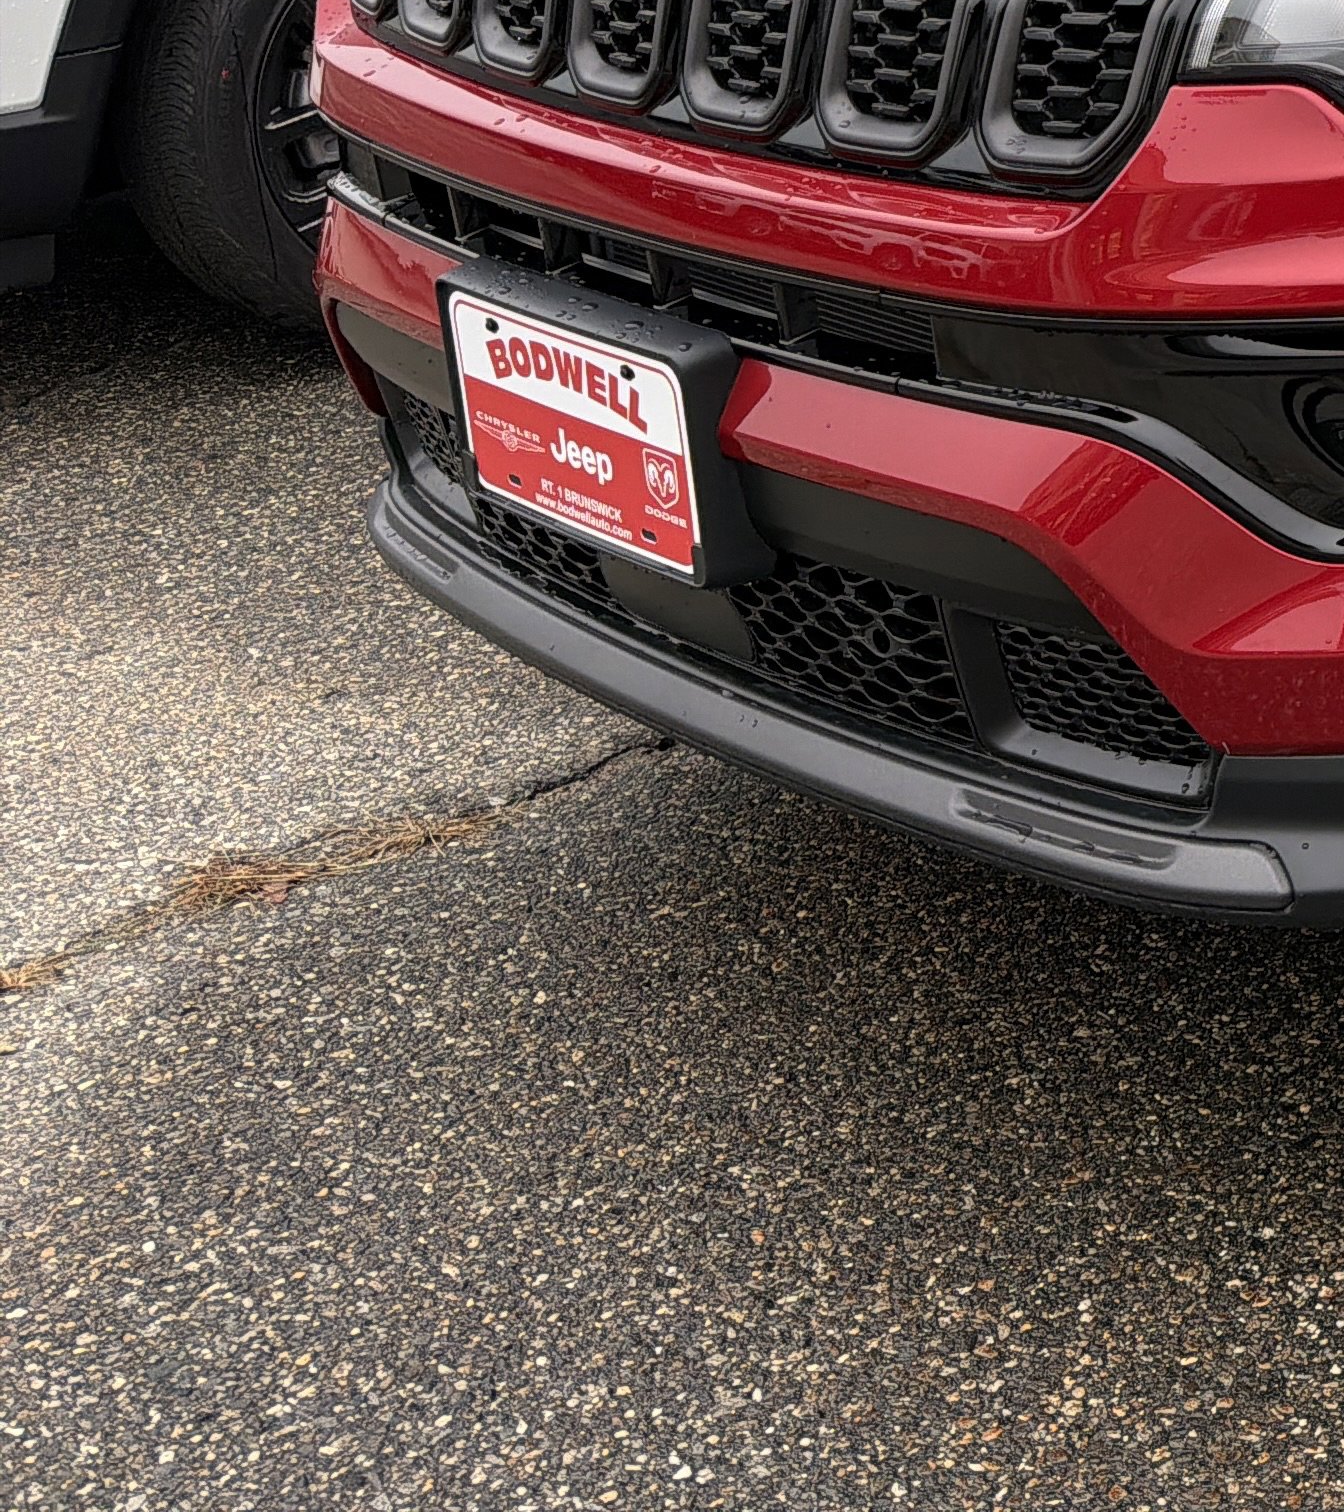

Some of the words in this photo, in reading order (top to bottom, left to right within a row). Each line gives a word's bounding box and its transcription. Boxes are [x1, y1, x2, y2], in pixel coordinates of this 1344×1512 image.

[486, 337, 648, 435] BODWELL
[475, 410, 541, 443] CHRYSLER
[550, 427, 613, 485] Jeep
[535, 492, 633, 541] www.bodwellauto.com
[541, 478, 556, 496] RT.
[557, 486, 563, 498] 1
[564, 488, 622, 523] BRUNSWICK
[644, 505, 688, 529] DODGE
